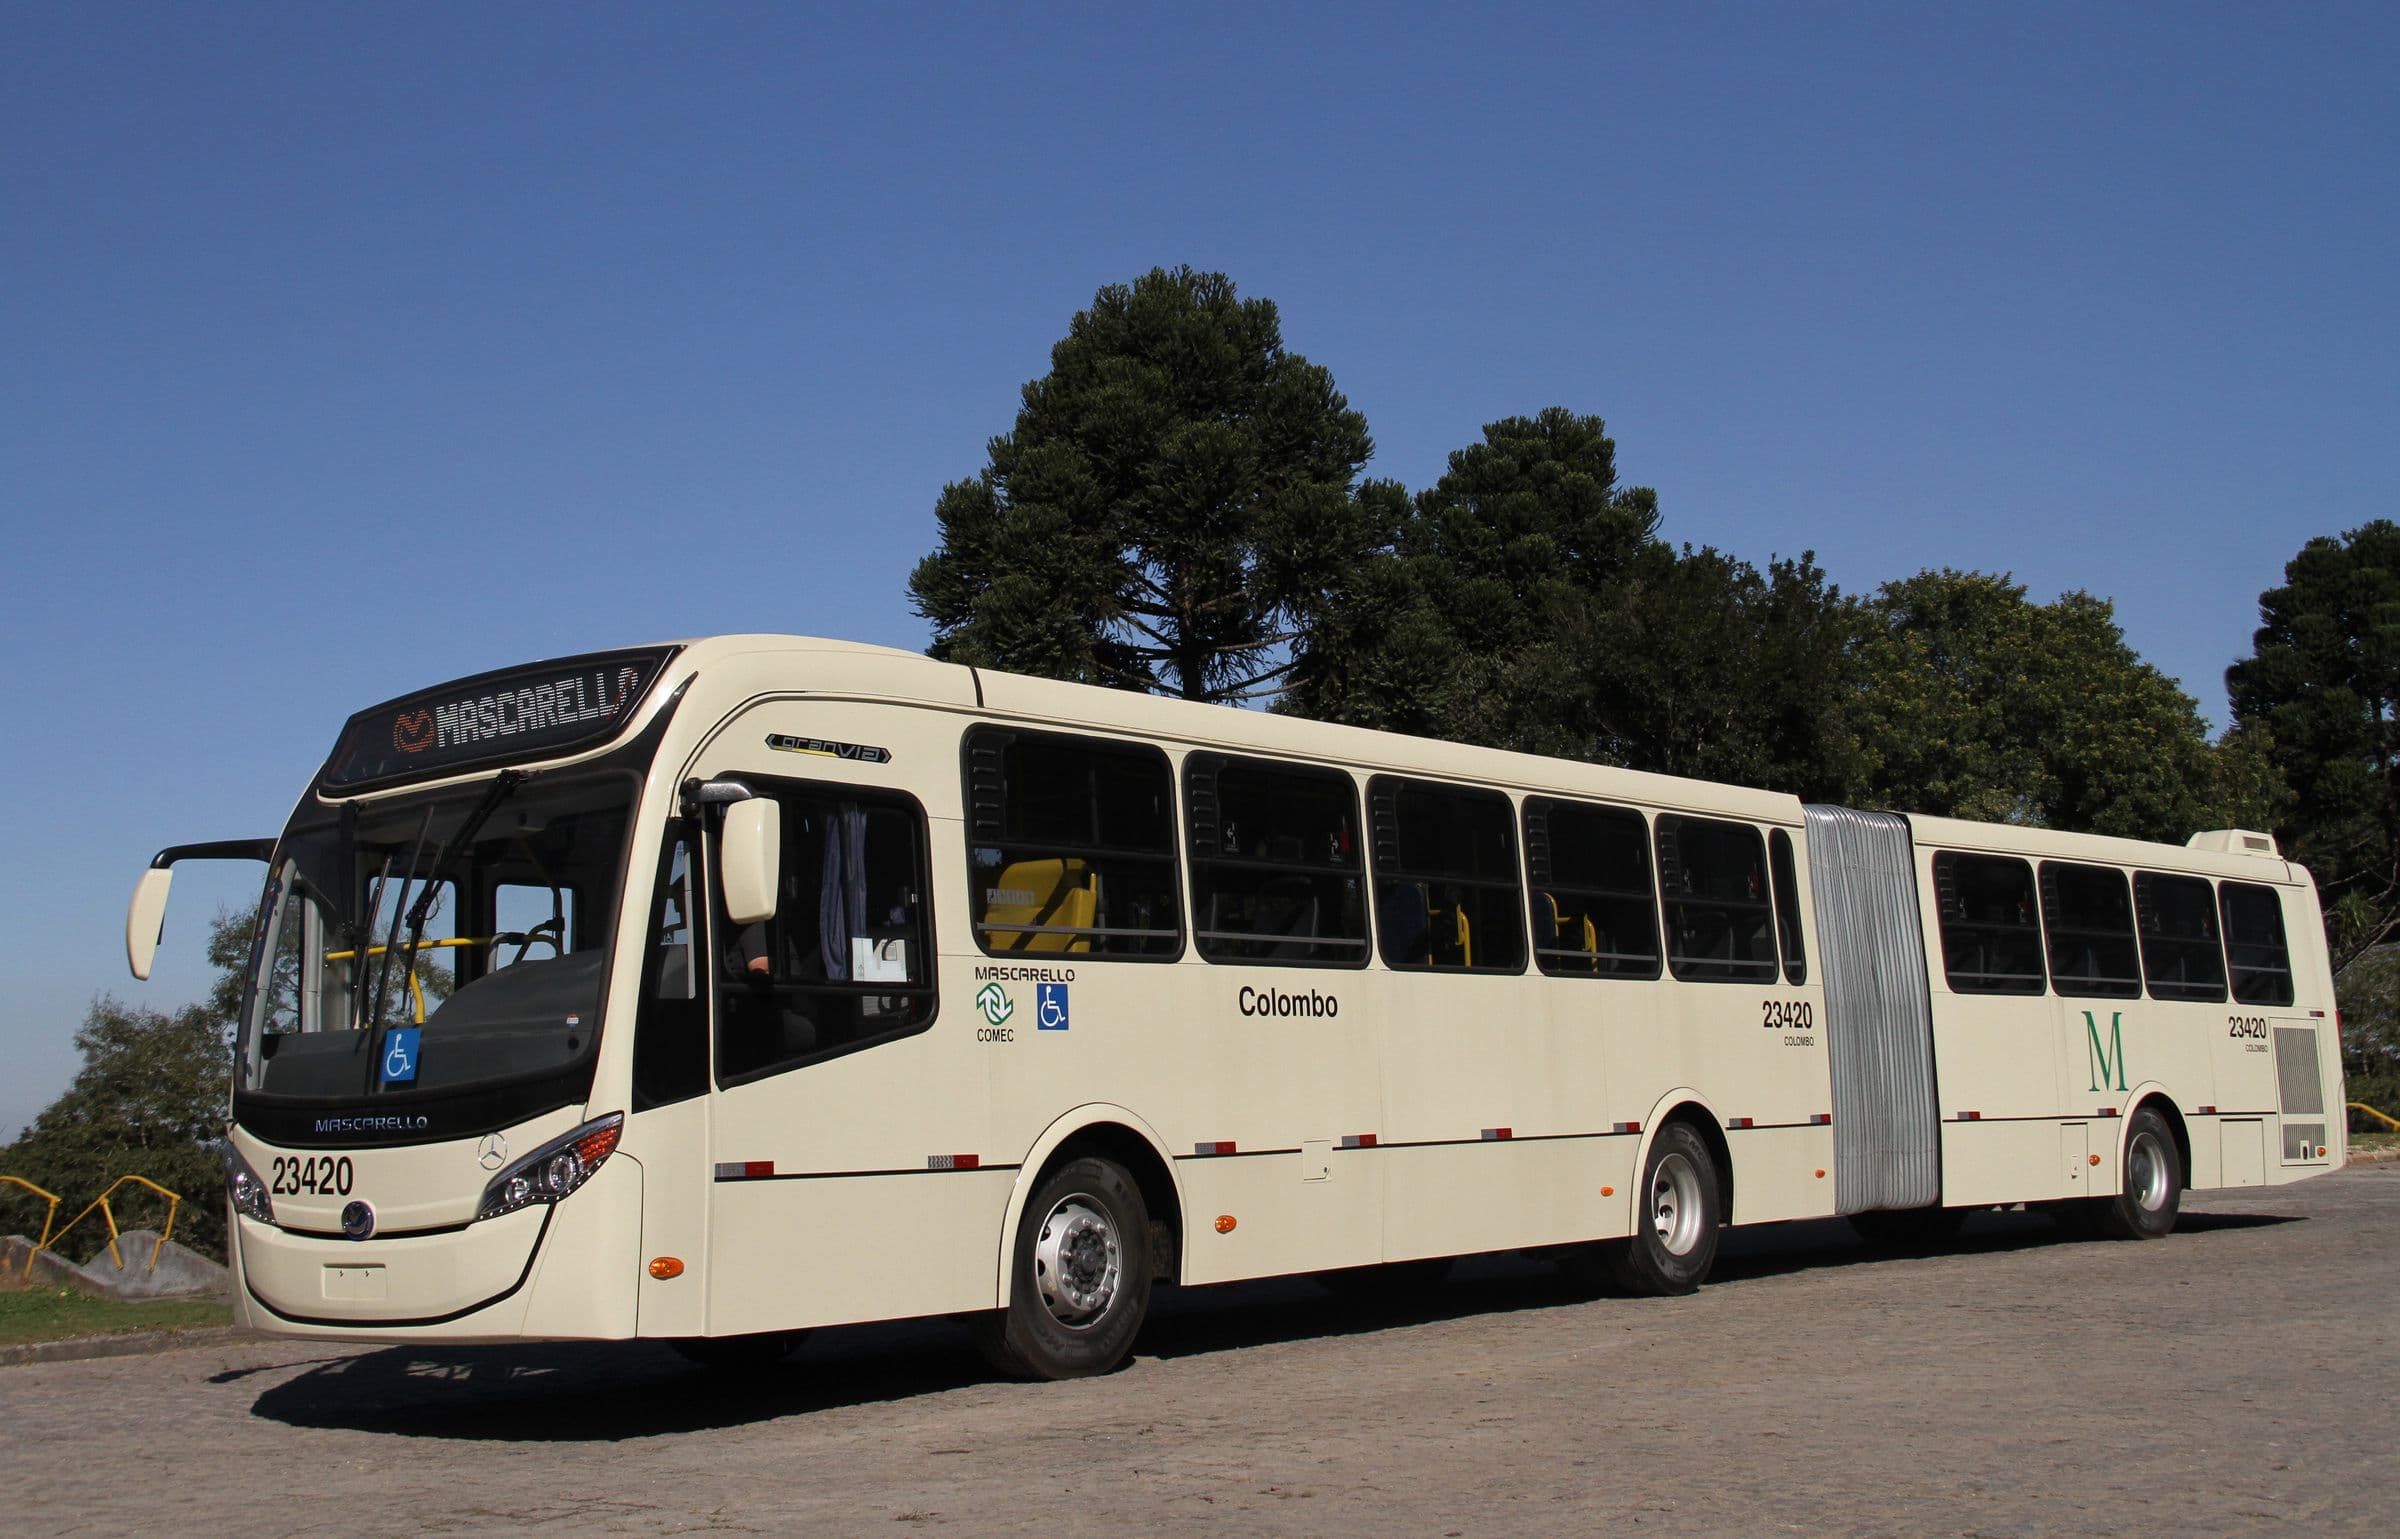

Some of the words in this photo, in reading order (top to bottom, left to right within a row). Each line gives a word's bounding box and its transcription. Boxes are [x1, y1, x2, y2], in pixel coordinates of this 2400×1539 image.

[975, 966, 1075, 982] MASCARELLO
[1239, 985, 1338, 1018] Colombo
[1762, 1000, 1813, 1029] 23420
[976, 1028, 1014, 1042] COMEC
[2228, 1016, 2266, 1039] 23420
[1784, 1035, 1815, 1047] COLOMBO
[2081, 1010, 2129, 1092] M
[315, 1116, 428, 1133] MASCARELLO
[271, 1155, 354, 1196] 23420
